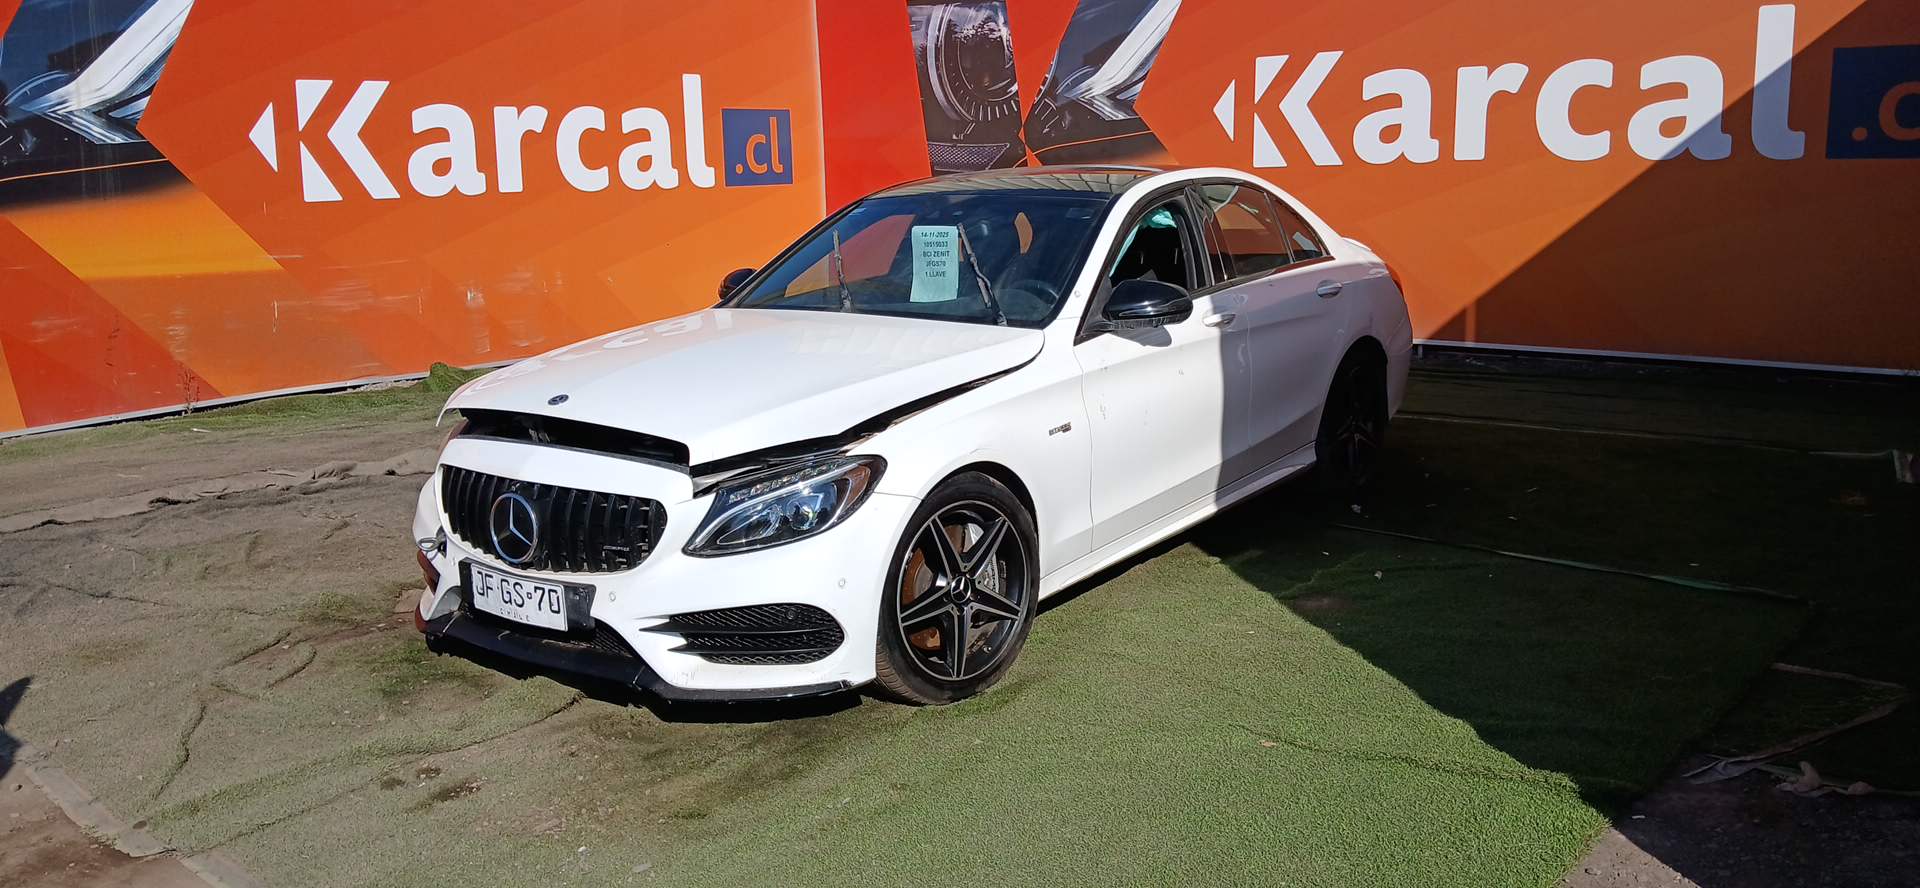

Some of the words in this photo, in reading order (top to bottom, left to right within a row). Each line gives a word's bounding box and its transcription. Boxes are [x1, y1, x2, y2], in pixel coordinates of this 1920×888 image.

[296, 73, 716, 203] Karcal
[736, 117, 784, 175] .cl
[1252, 3, 1806, 168] Karcal
